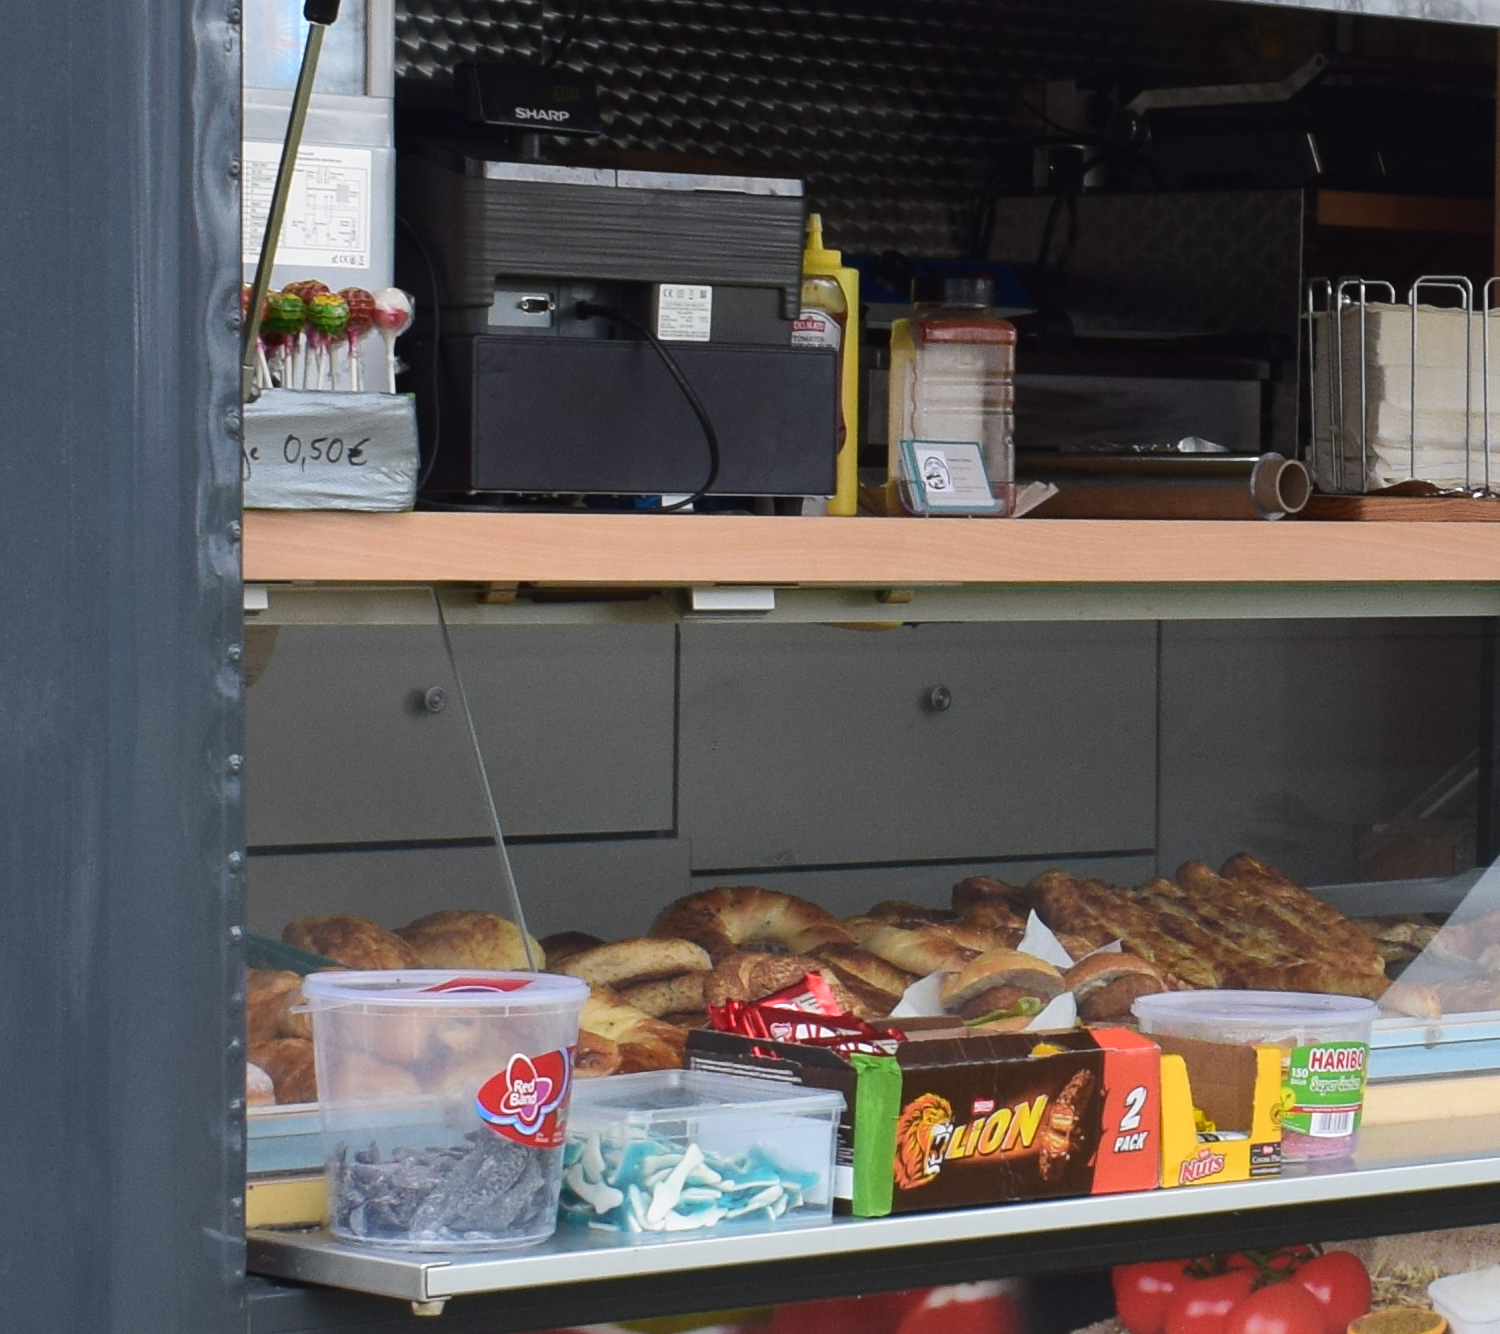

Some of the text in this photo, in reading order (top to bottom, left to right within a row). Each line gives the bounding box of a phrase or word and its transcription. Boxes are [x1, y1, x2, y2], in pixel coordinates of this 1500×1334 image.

[515, 107, 570, 122] SHARP
[283, 433, 371, 473] 0,50€
[1309, 1046, 1365, 1072] HARIBO
[1291, 1068, 1309, 1078] 150
[513, 1079, 536, 1094] Red
[509, 1091, 538, 1107] Band
[1119, 1086, 1148, 1133] 2
[1113, 1131, 1149, 1153] PACK
